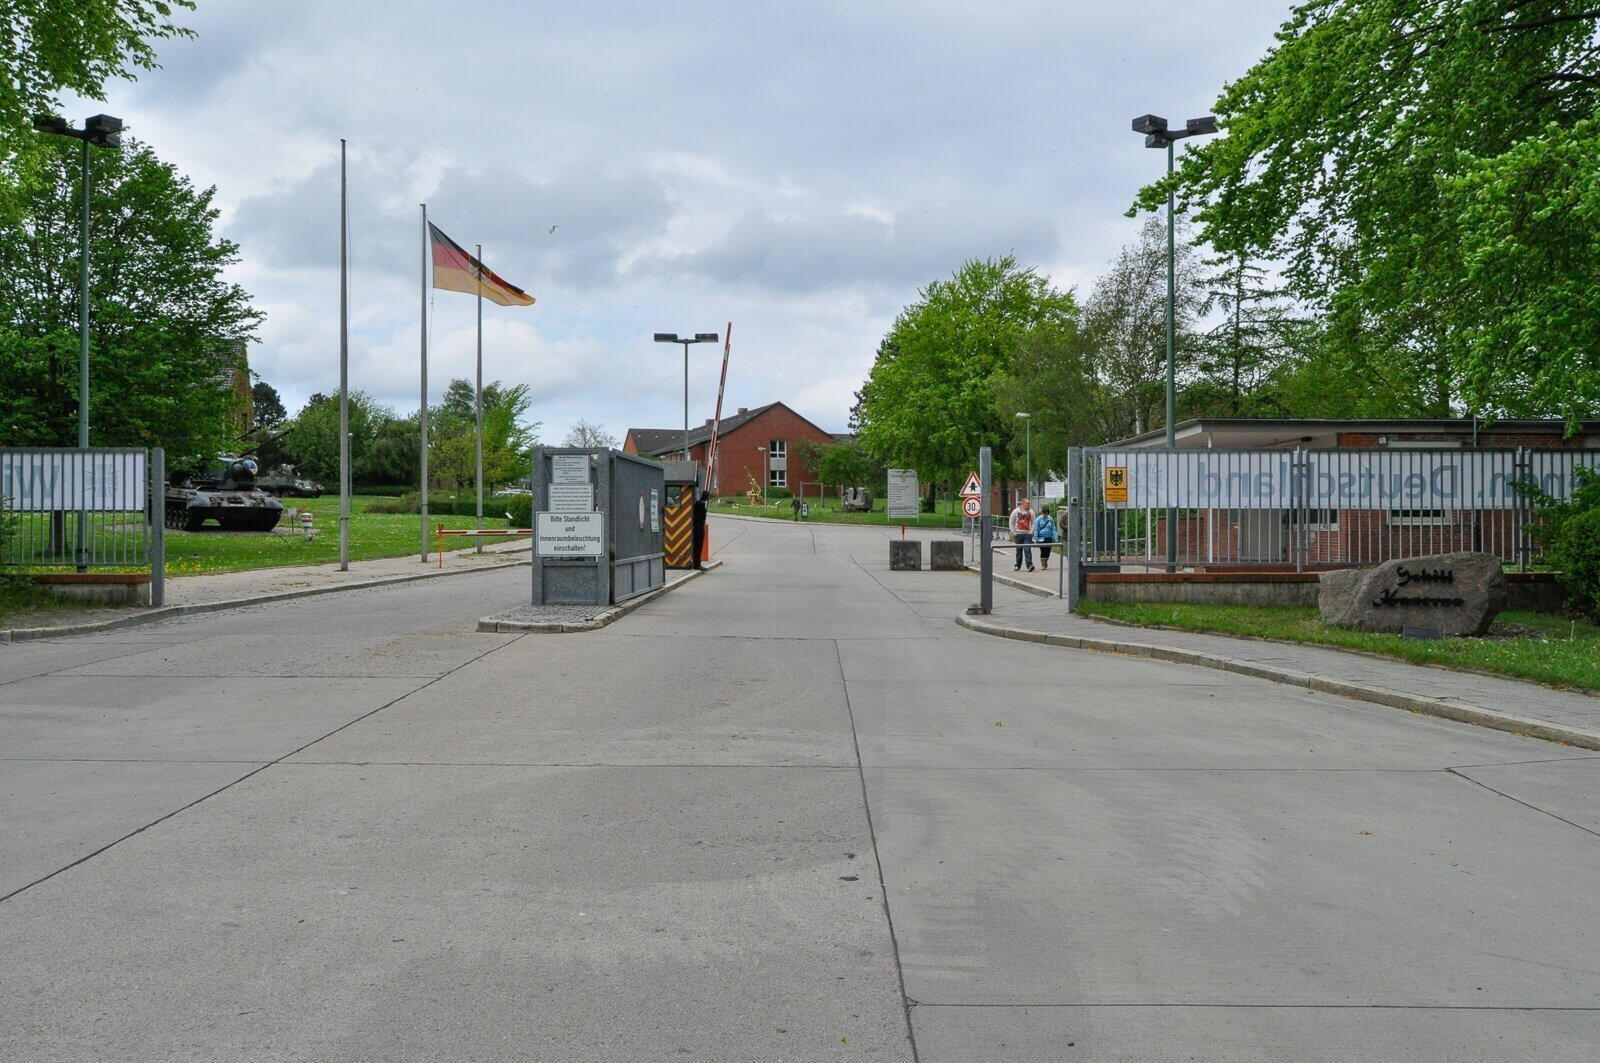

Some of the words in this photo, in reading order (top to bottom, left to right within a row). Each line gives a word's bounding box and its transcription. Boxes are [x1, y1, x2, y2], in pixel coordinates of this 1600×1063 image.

[967, 502, 976, 511] 30
[550, 515, 562, 523] Bitte
[563, 515, 590, 523] Standlicht
[539, 534, 601, 544] Innenraumbeleuchtung
